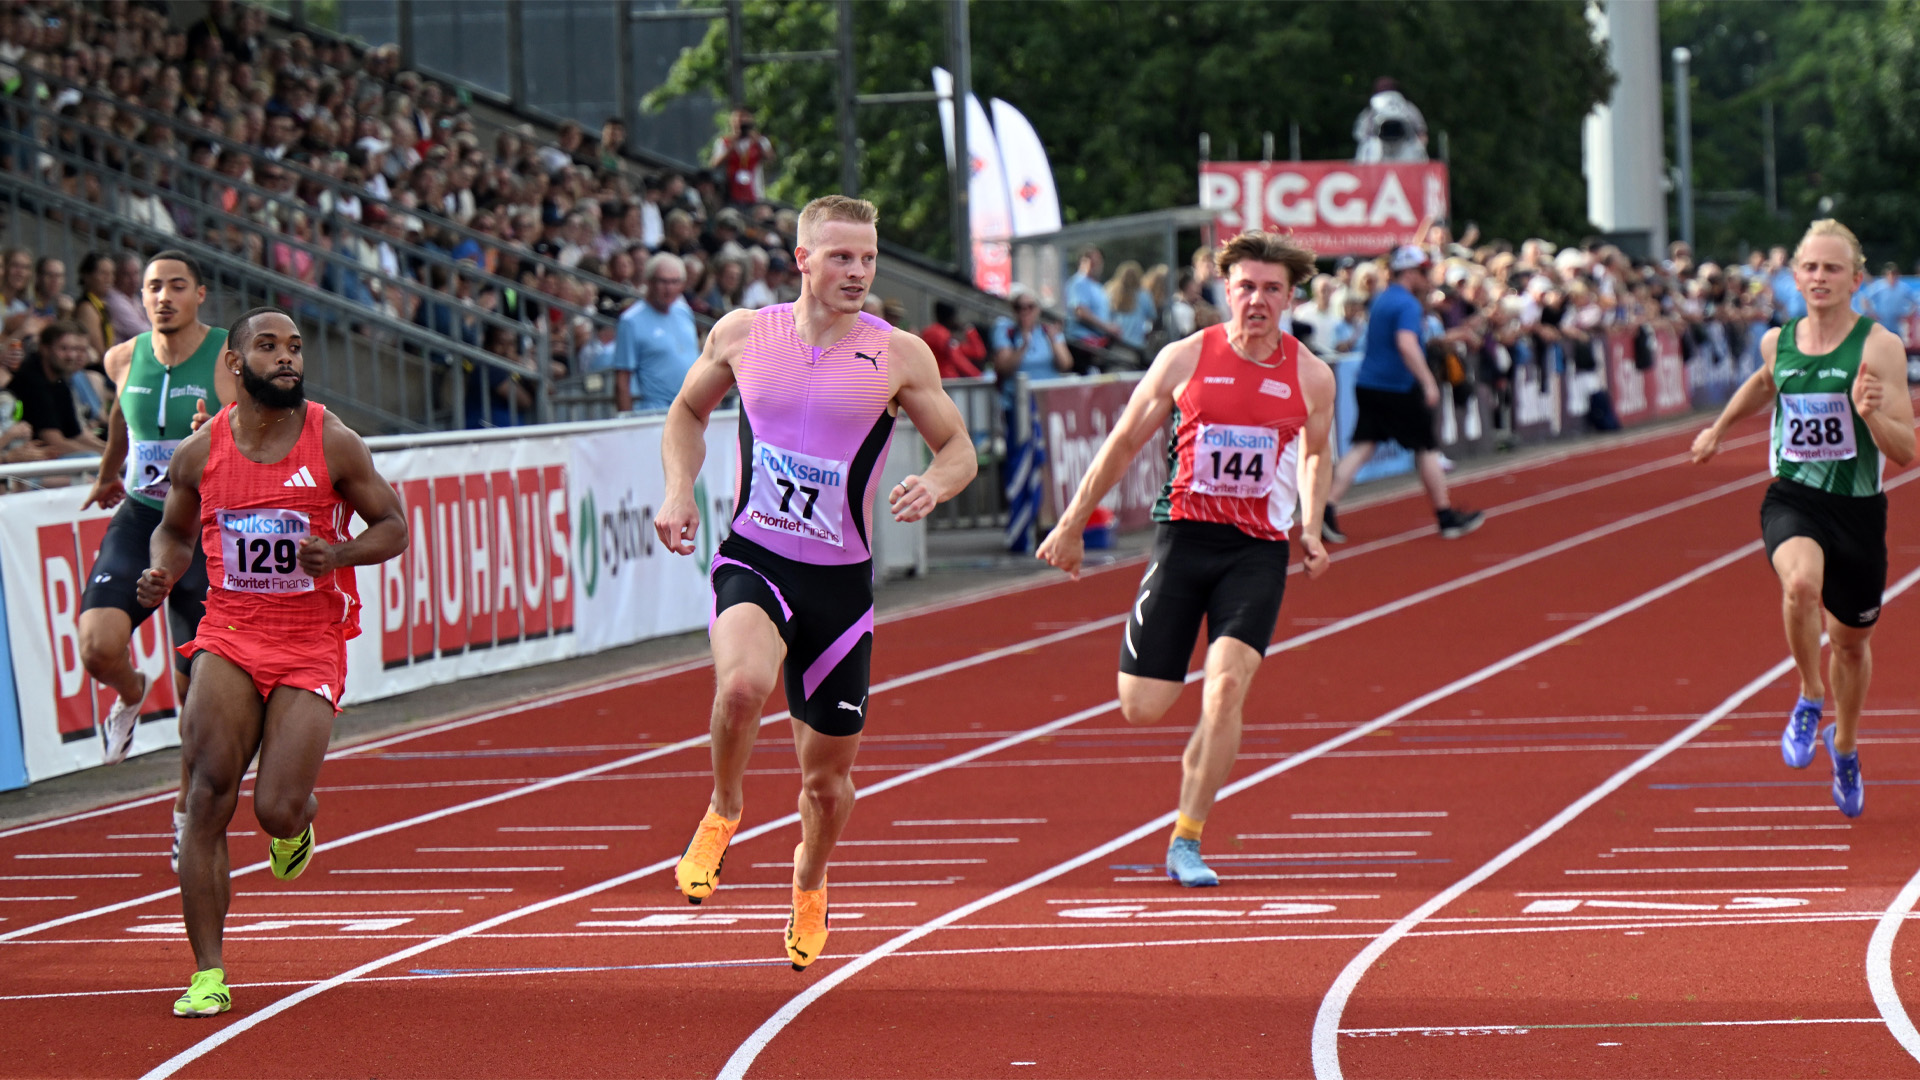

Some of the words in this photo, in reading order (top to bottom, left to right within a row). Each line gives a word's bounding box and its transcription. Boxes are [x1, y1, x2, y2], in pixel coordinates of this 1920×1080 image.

[1199, 169, 1418, 231] RIGGA
[1203, 429, 1274, 449] Folksam
[1790, 417, 1844, 446] 238
[760, 447, 841, 487] Folksam
[1211, 451, 1264, 482] 144
[776, 478, 820, 520] 77
[223, 513, 305, 534] Folksam
[750, 510, 802, 533] Prioritet
[802, 523, 840, 543] Finans
[236, 538, 297, 575] 129
[384, 488, 570, 633] BAUHAUS
[227, 573, 270, 590] Prioritet
[272, 577, 310, 590] Finans
